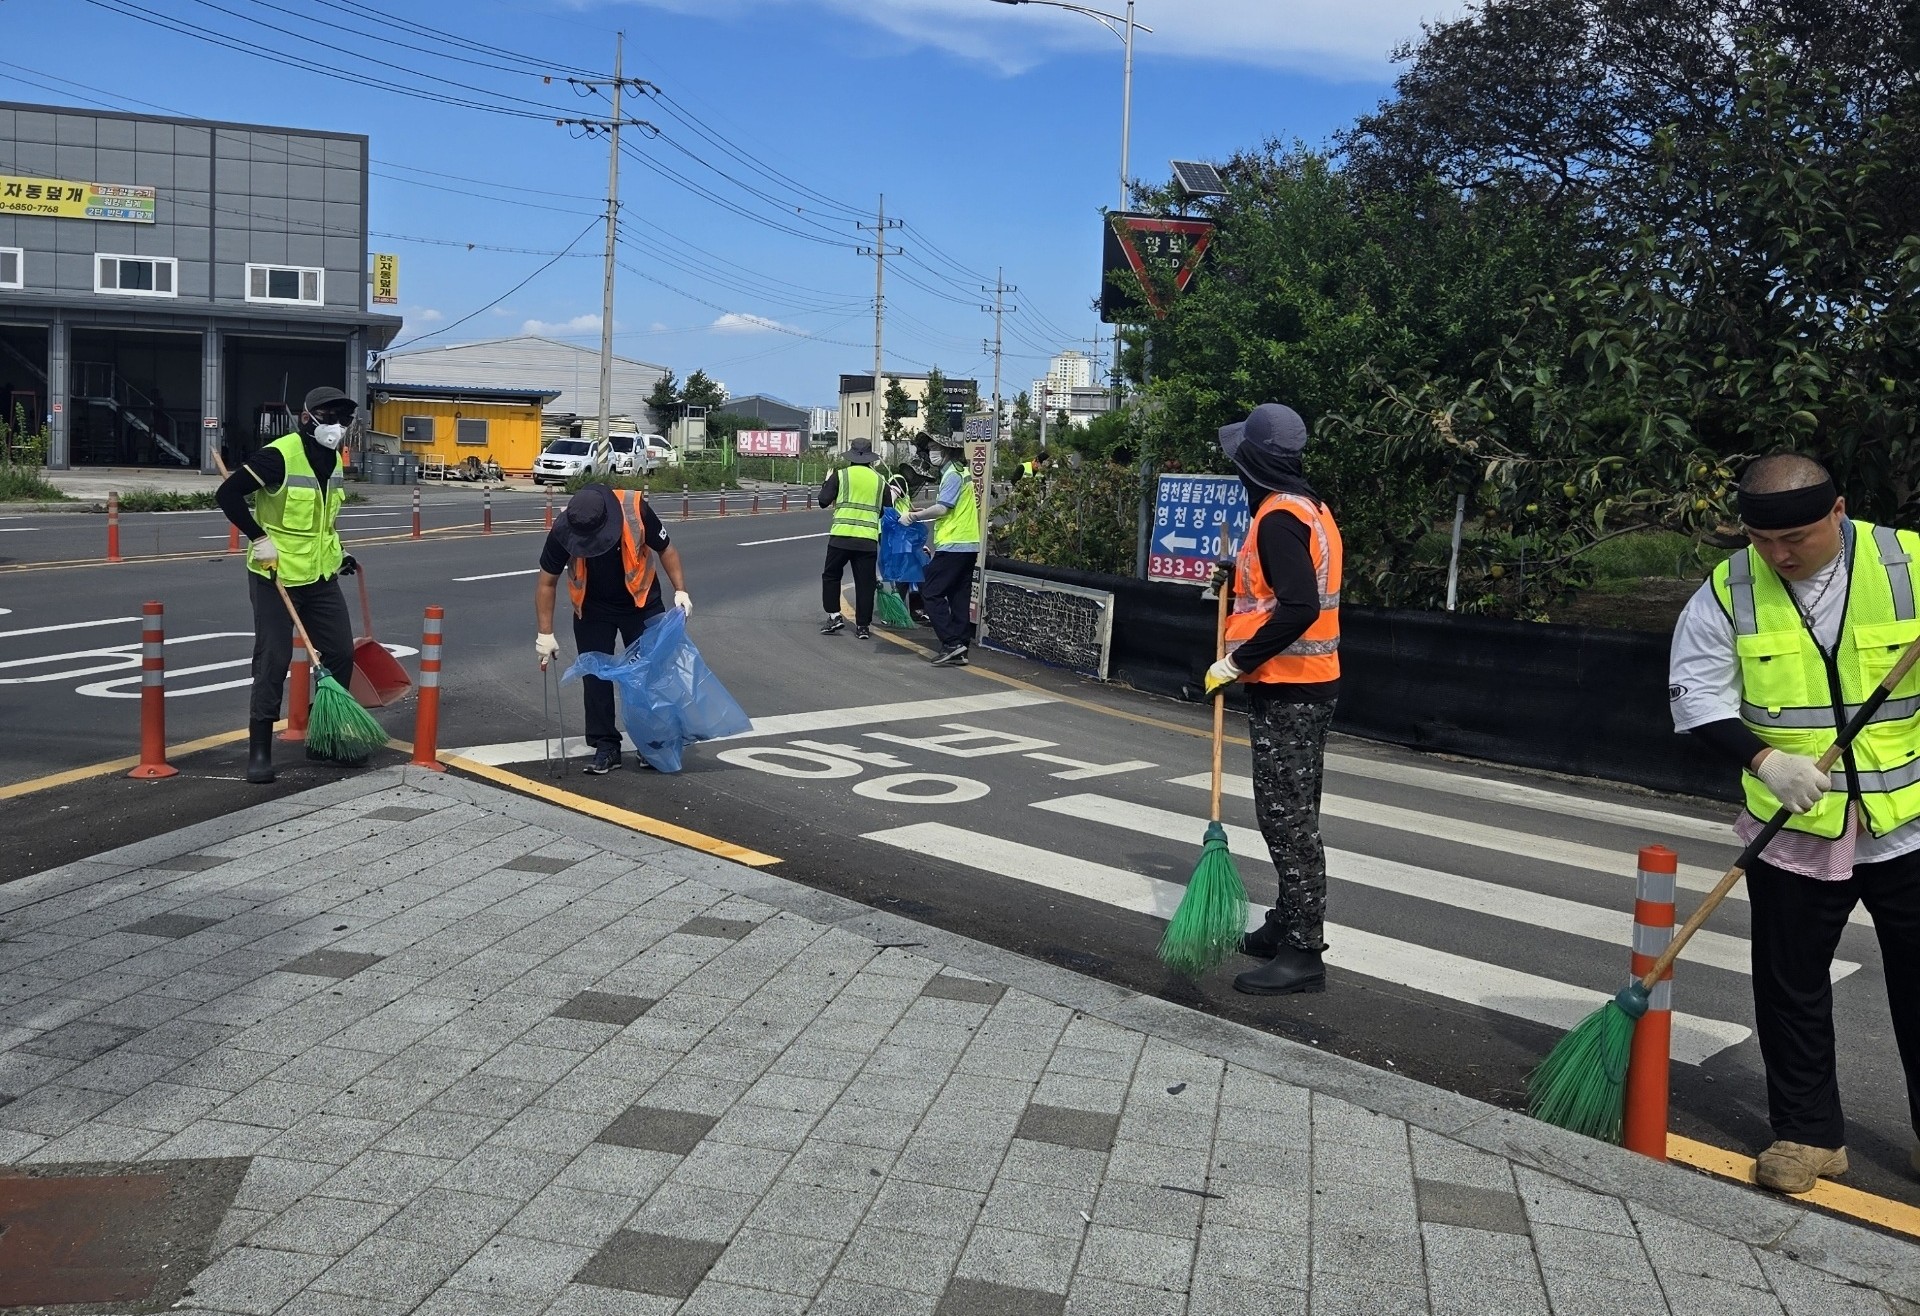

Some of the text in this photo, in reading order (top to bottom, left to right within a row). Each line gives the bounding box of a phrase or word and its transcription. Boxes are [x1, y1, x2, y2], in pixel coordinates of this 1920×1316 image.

[4, 183, 83, 202] 자동덮개
[1145, 236, 1182, 253] 양보
[739, 431, 798, 452] 화신목재
[1151, 556, 1217, 579] 333-93
[716, 723, 1160, 804] 양보
